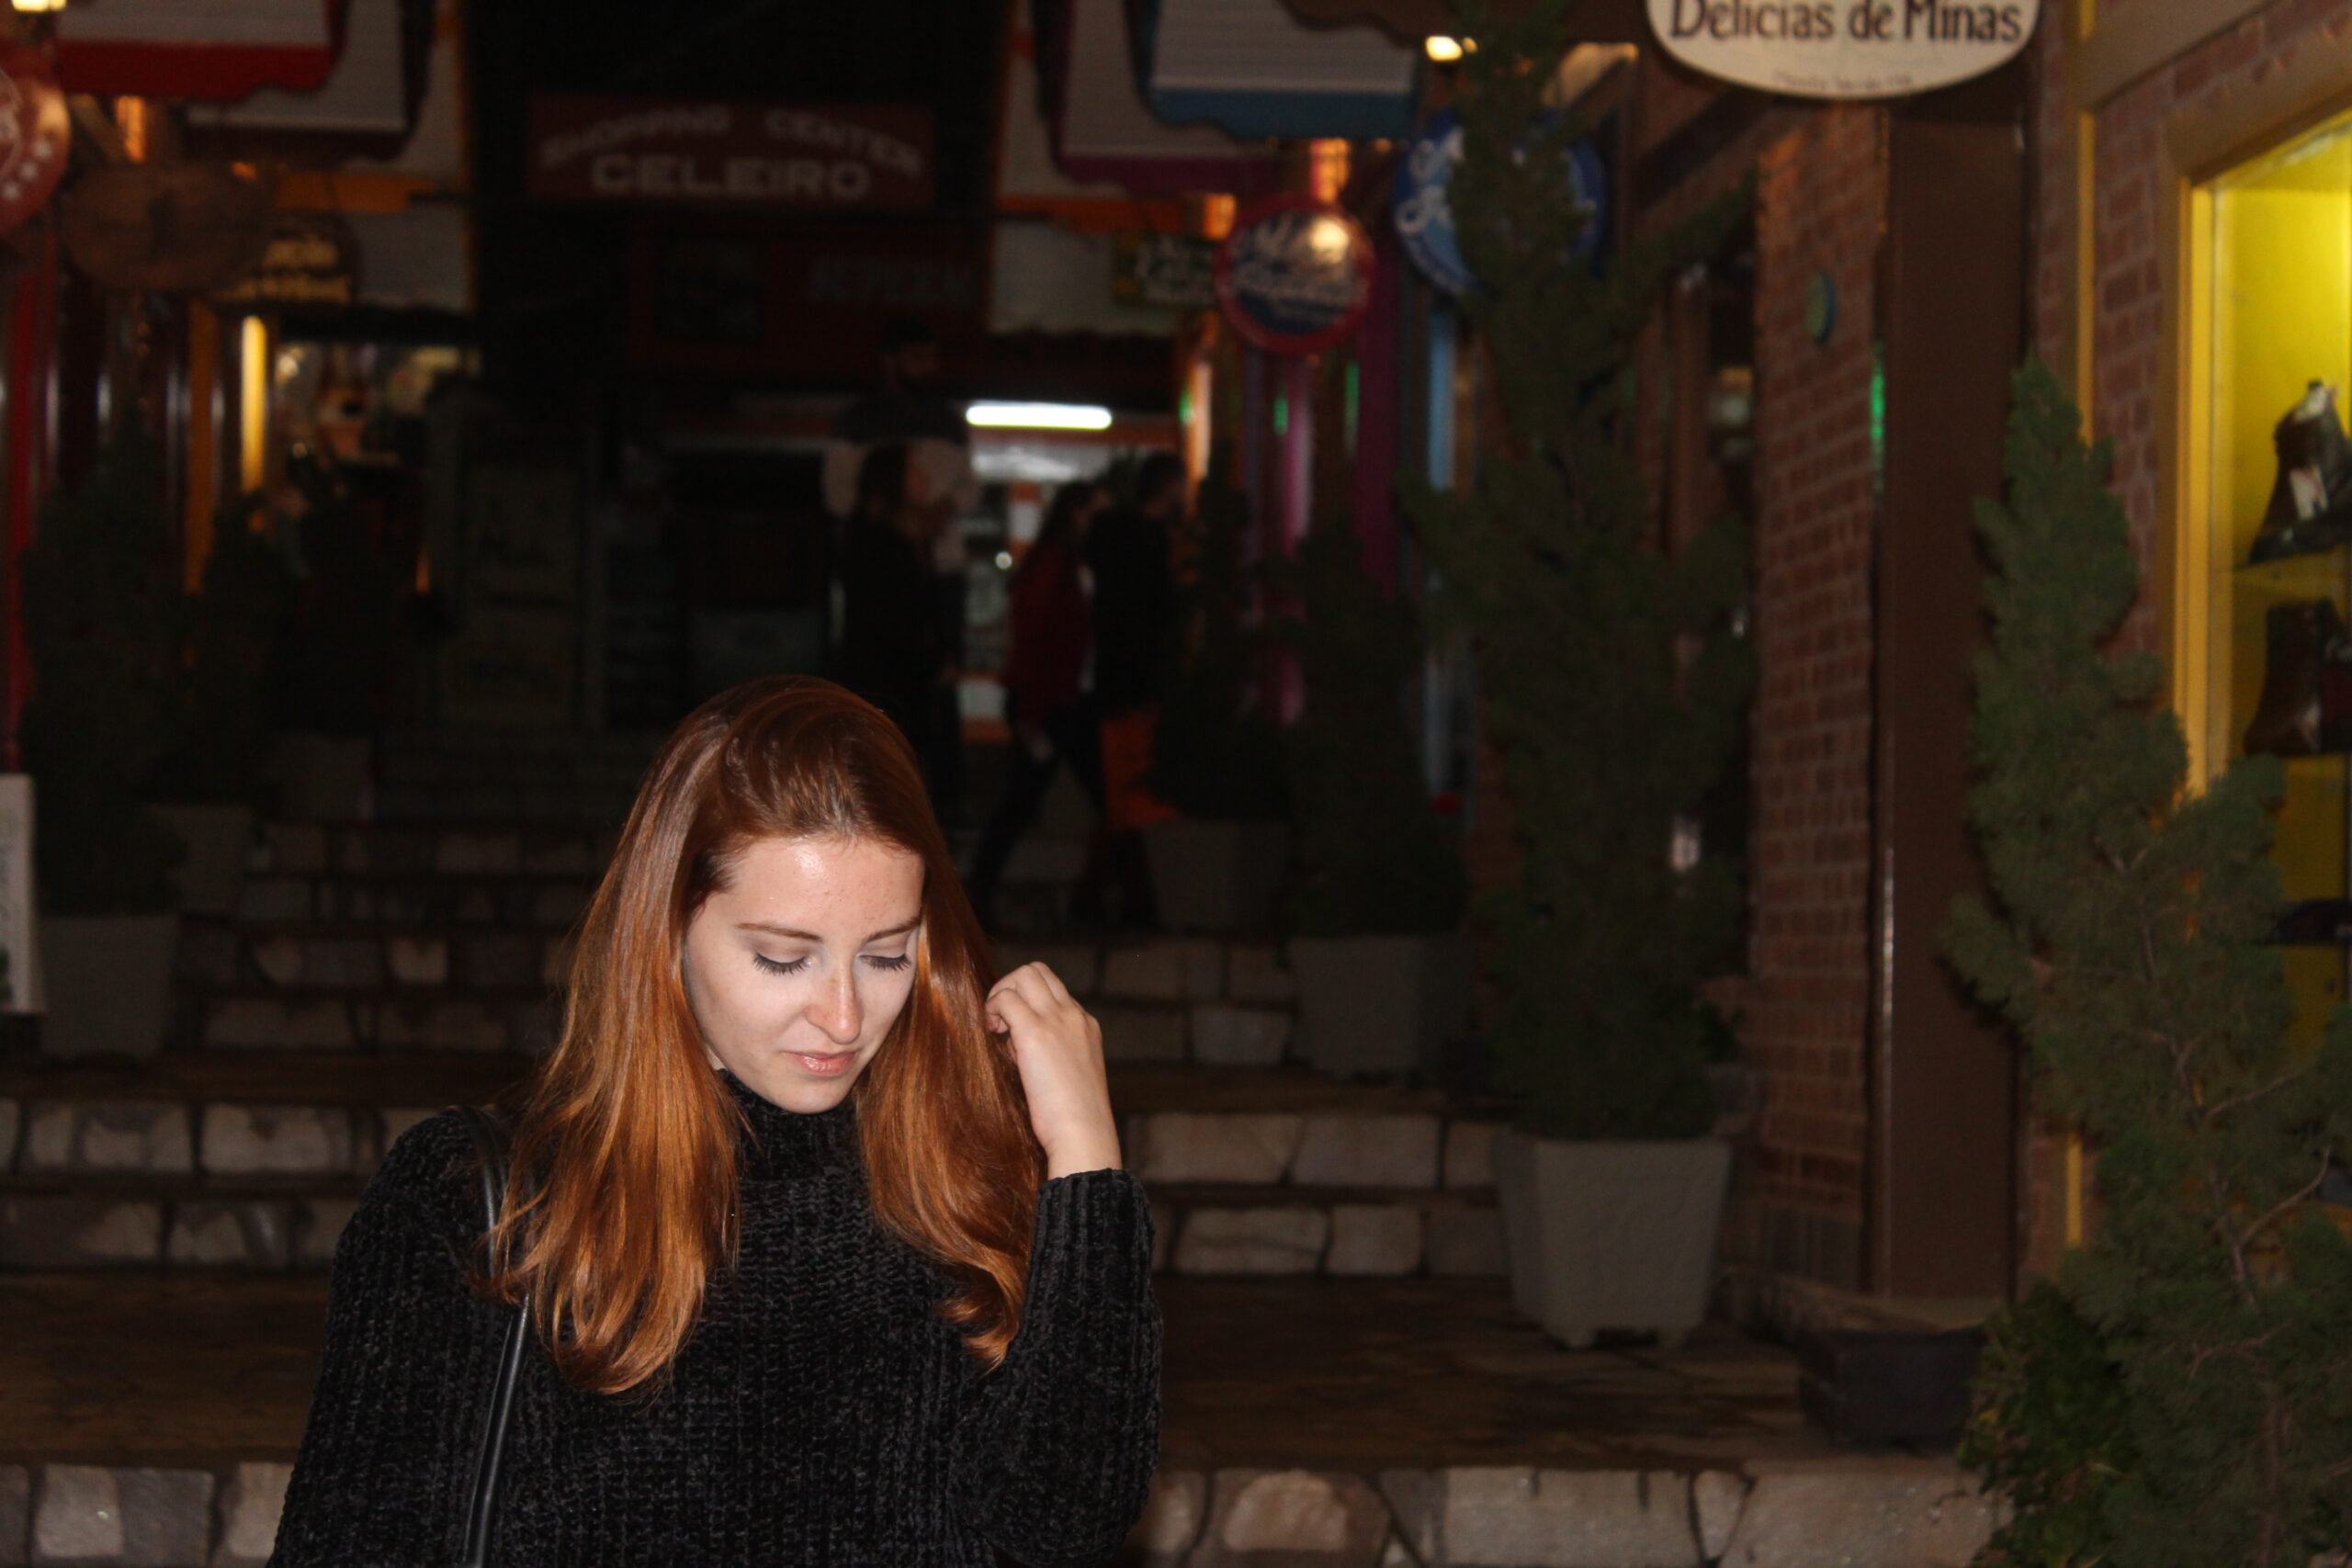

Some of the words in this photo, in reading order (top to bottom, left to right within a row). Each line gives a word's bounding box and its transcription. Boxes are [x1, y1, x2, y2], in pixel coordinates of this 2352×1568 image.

[1848, 0, 1894, 40] de
[1903, 0, 2023, 42] Minas
[764, 107, 924, 178] CENTER
[591, 152, 872, 199] CELEIRO
